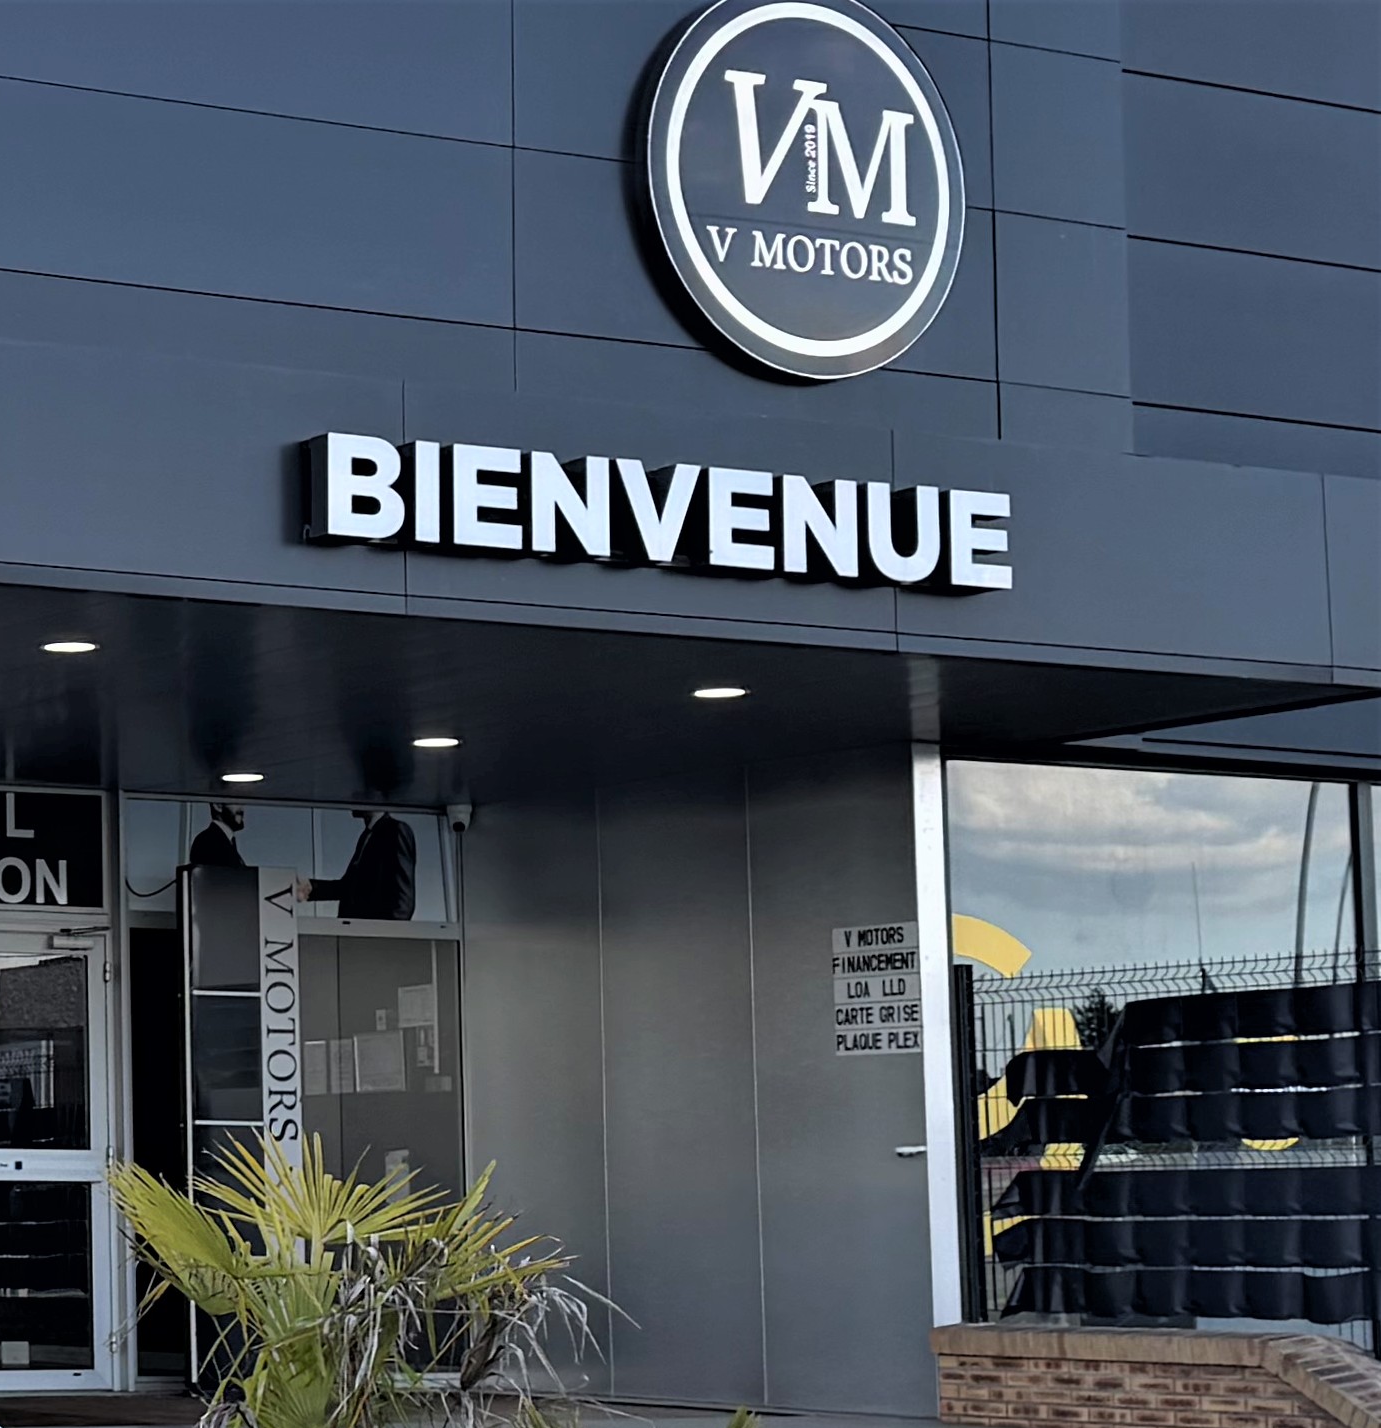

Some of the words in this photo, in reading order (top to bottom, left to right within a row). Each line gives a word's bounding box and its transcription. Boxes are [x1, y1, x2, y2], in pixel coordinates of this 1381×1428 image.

[724, 69, 916, 226] VM
[804, 124, 816, 158] 2019
[706, 225, 738, 263] V
[750, 230, 914, 286] MOTORS
[325, 431, 1013, 590] BIENVENUE
[263, 883, 294, 919] V
[844, 930, 852, 948] V
[857, 926, 905, 947] MOTORS
[832, 951, 916, 974] FINANCEMENT
[847, 981, 871, 1000] LOA
[882, 977, 906, 998] LLD
[836, 1006, 874, 1026] CARTE
[879, 1003, 919, 1024] GRISE
[264, 937, 299, 1143] MOTORS
[836, 1032, 882, 1052] PLAQUE
[887, 1029, 921, 1049] PLEX
